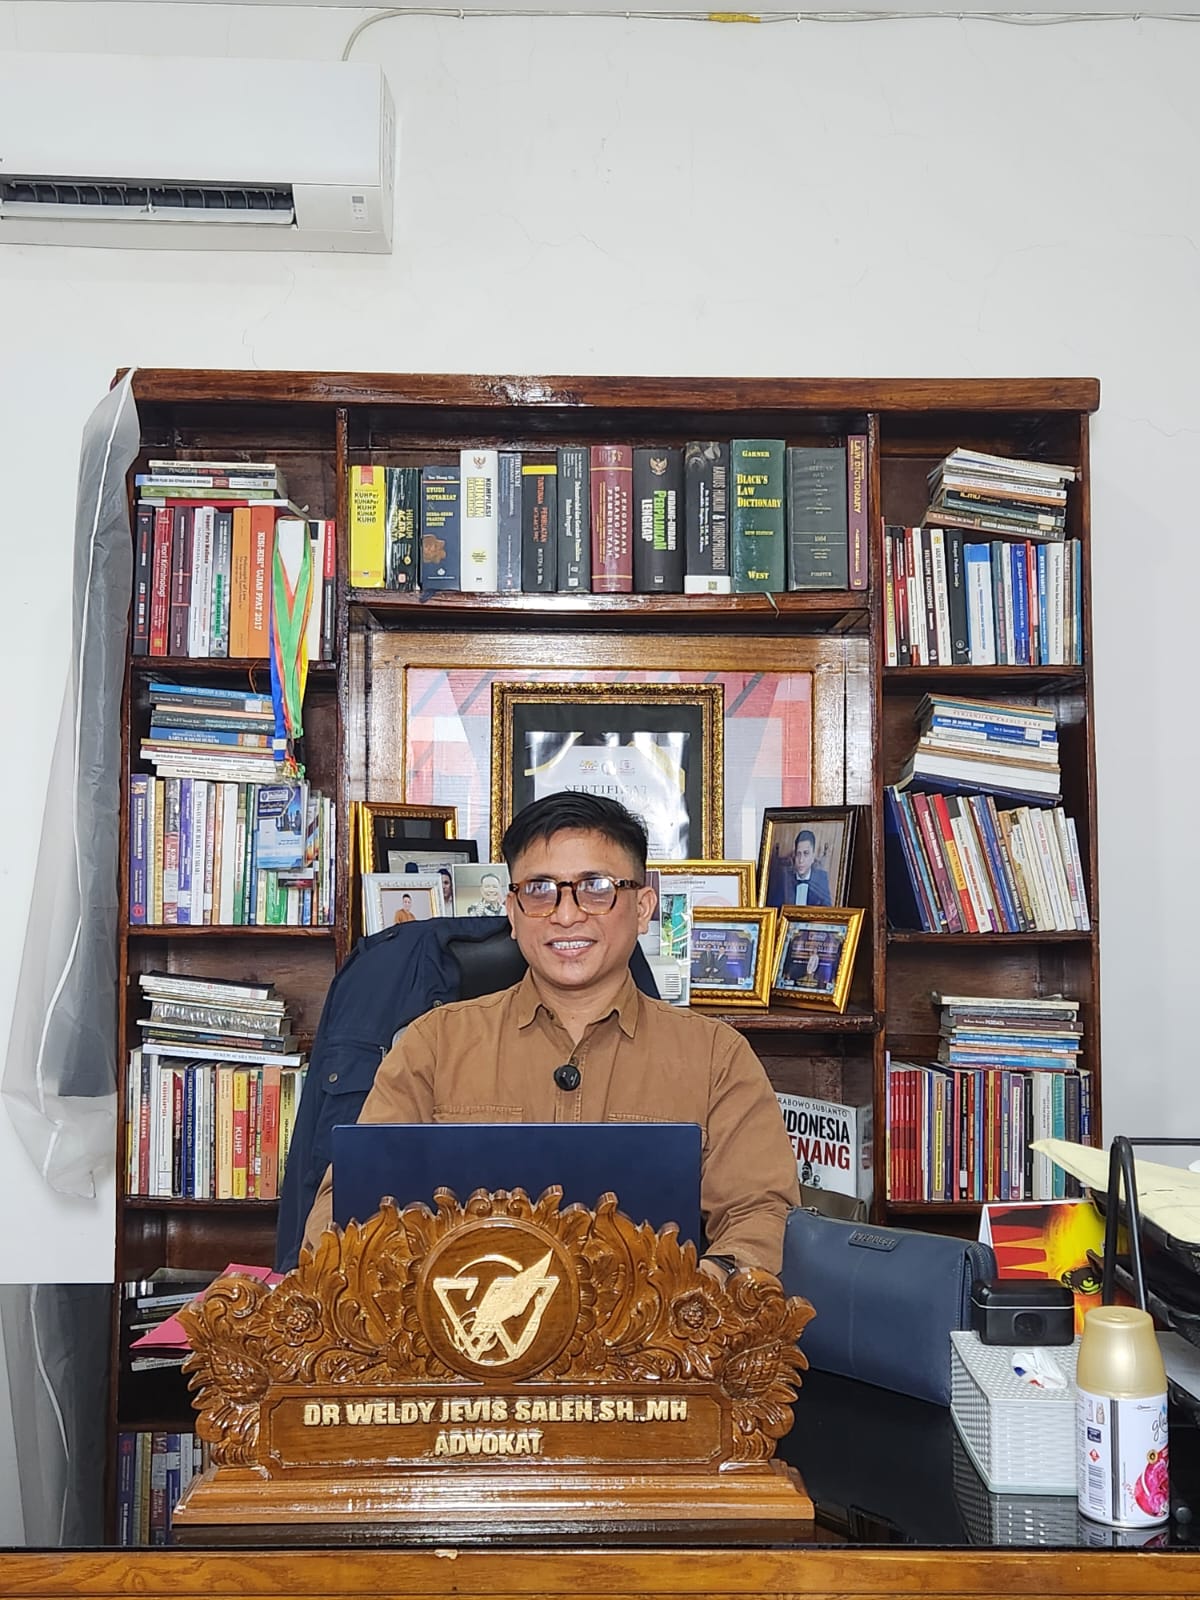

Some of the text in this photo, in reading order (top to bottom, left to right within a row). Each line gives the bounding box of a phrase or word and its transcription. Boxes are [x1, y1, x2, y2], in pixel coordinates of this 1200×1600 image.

[713, 466, 725, 488] KAMUS
[736, 474, 768, 485] BLACK'S
[712, 490, 725, 512] HUKUM
[736, 486, 755, 496] LAW
[736, 498, 782, 508] DICTIONARY
[398, 509, 406, 539] ACARA
[405, 509, 413, 539] HUKUM
[641, 499, 652, 542] LENGKAP
[654, 490, 667, 550] PERPAJAKAN
[668, 490, 676, 550] UNDANG-UNDANG
[712, 522, 725, 570] YURISPRUDENSI
[158, 542, 169, 597] Teori Kriminologi
[255, 569, 264, 591] UJIAN
[748, 570, 770, 579] WEST
[255, 592, 263, 611] PPAT
[925, 577, 933, 609] EKONOMI
[254, 612, 262, 630] 2017
[564, 784, 648, 794] SERTIFIAT
[778, 1097, 848, 1118] ABOWO SUBIANTO
[783, 1109, 850, 1144] DONESIA
[235, 1126, 243, 1154] KUHP
[788, 1135, 850, 1171] NANG
[304, 1404, 340, 1426] DR
[346, 1401, 435, 1425] WELDY
[440, 1400, 508, 1423] JEVIS
[1152, 1411, 1169, 1442] gla
[434, 1431, 544, 1456] ADVOKAT
